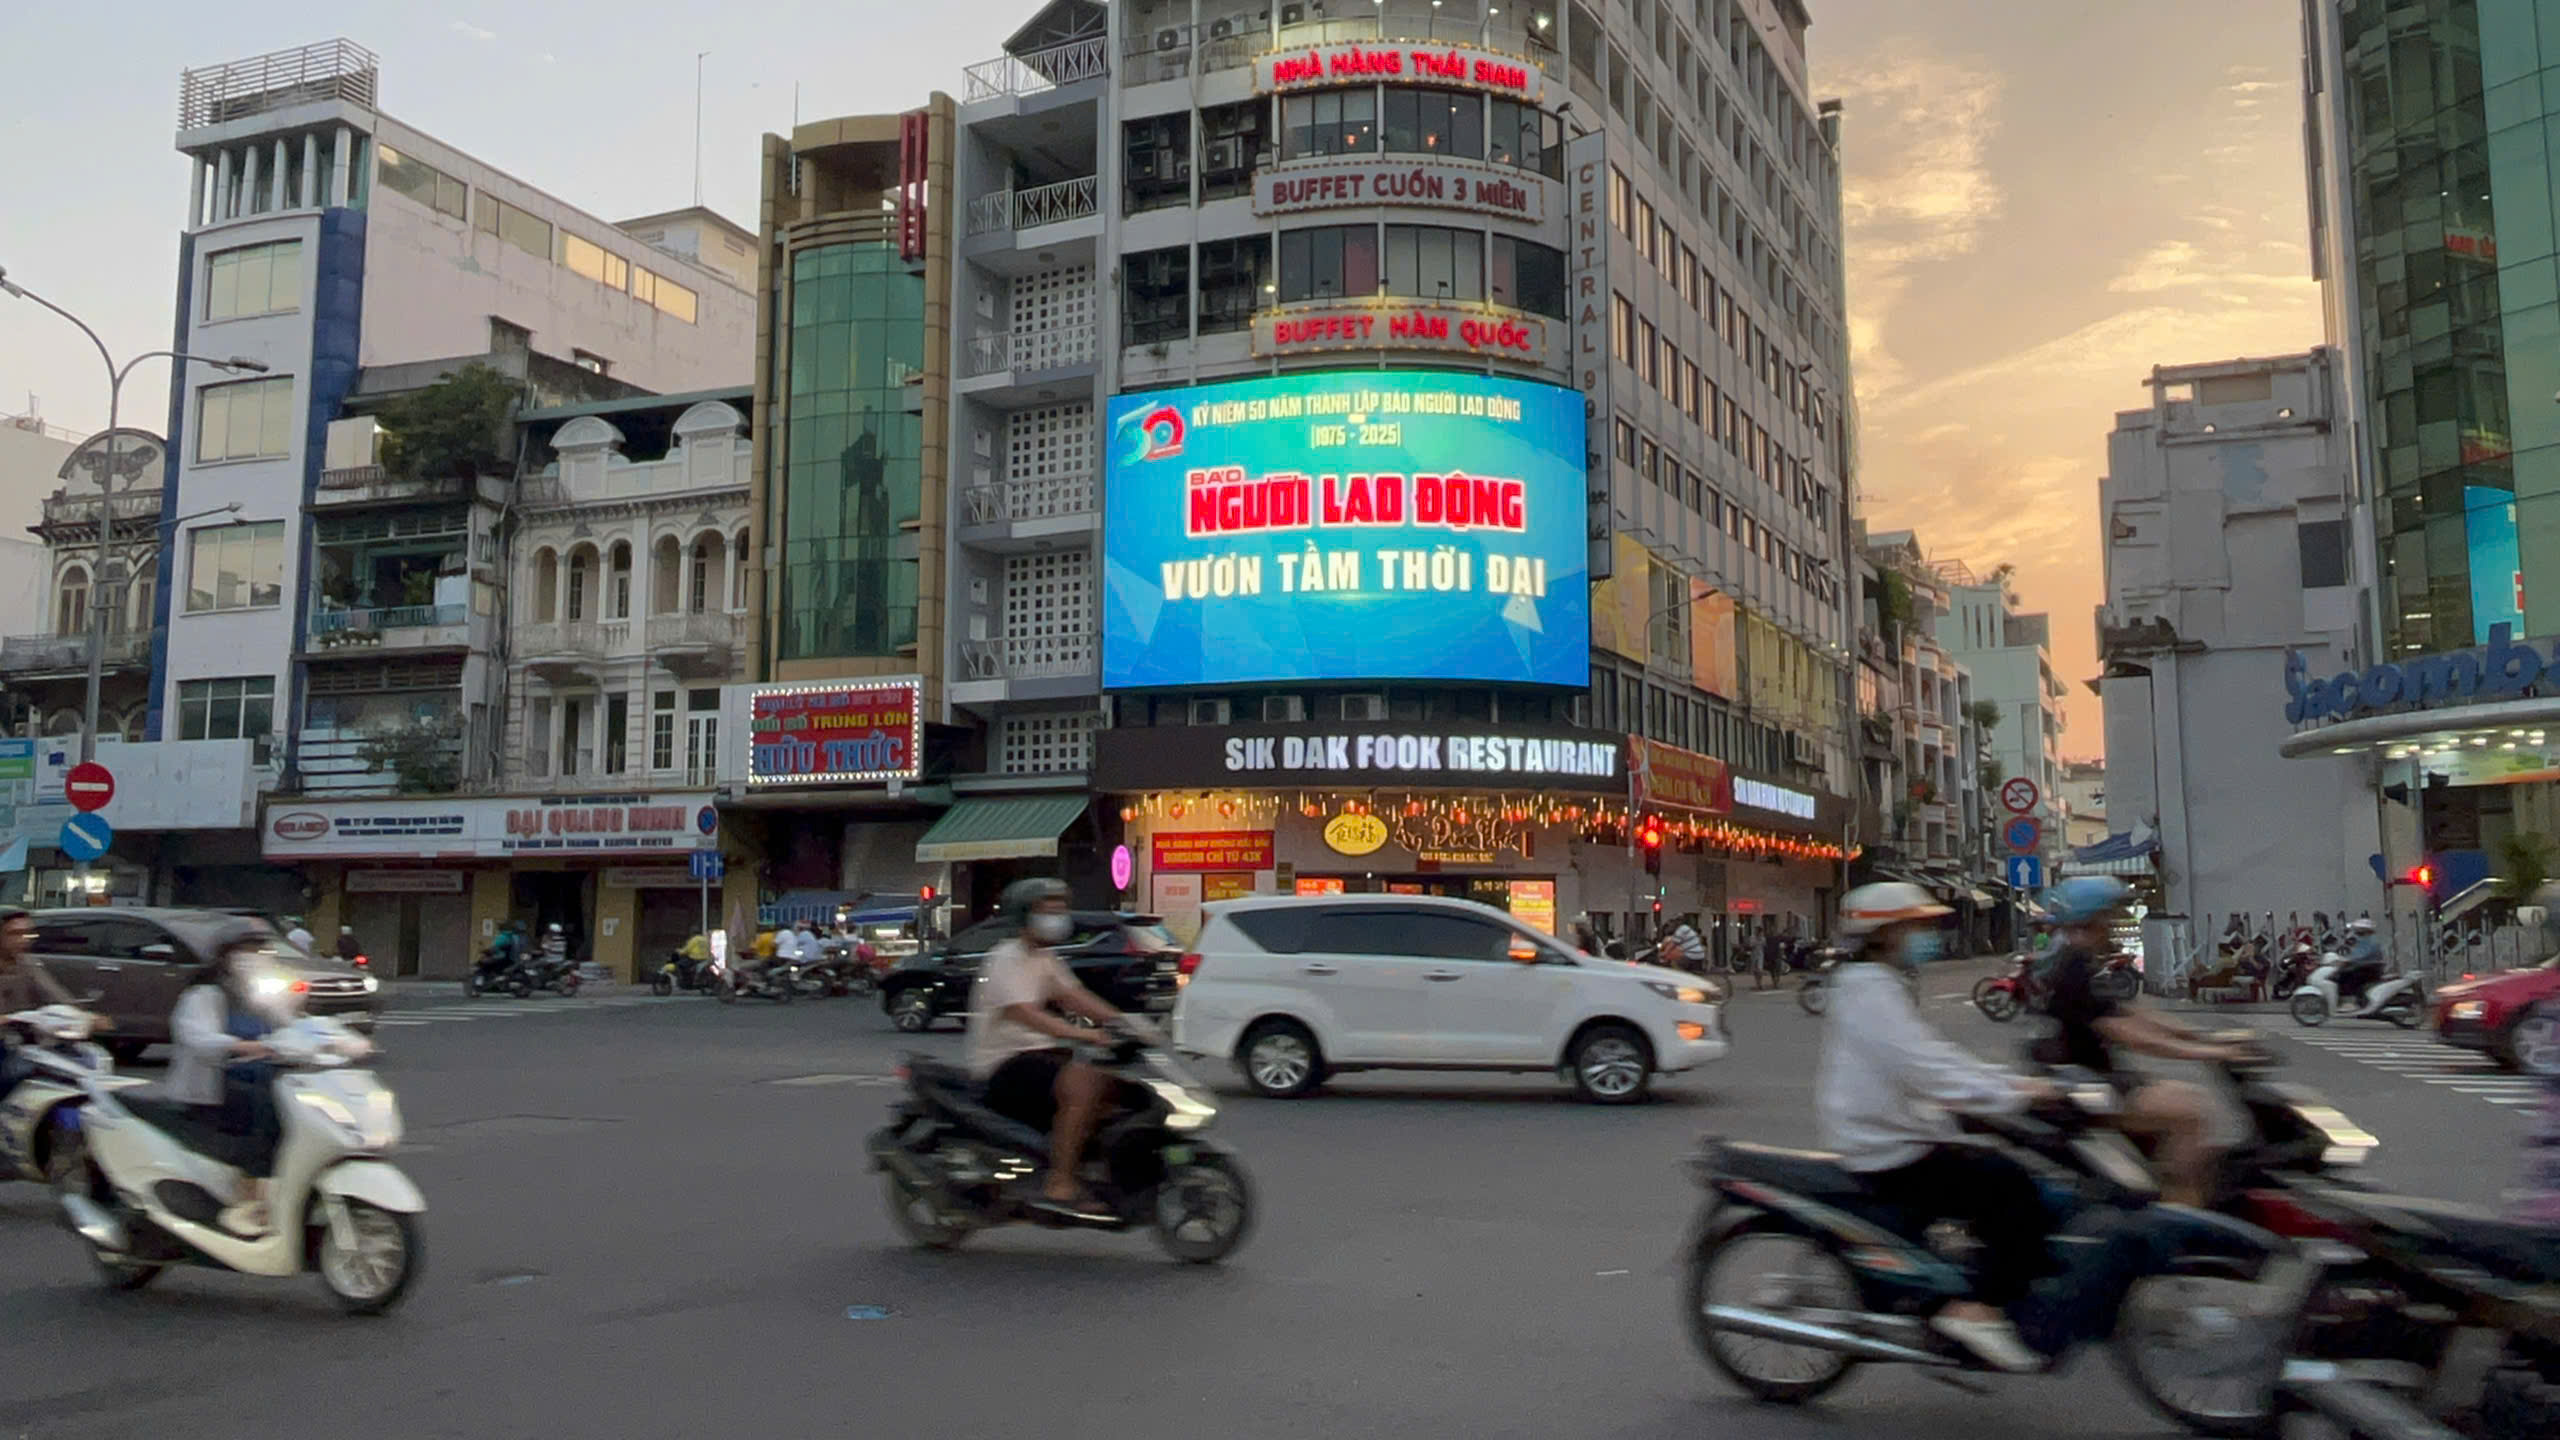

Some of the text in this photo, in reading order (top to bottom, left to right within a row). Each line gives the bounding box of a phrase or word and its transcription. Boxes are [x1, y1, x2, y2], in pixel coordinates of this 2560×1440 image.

[1273, 44, 1527, 91] NHÀ HÀNG THÁI SIAM
[1273, 168, 1527, 212] BUFFET CUỐN 3 MIỀN
[1579, 163, 1597, 353] CENTRAL
[1274, 310, 1532, 351] BUFFET HÀN QUỐC
[1249, 401, 1266, 421] 50
[1269, 395, 1302, 417] NĂM
[1306, 391, 1350, 415] THÀNH
[1460, 395, 1483, 416] LAO
[1190, 469, 1242, 485] BÁO
[1190, 475, 1310, 533] NGƯỜI
[1322, 477, 1401, 524] LAO
[1413, 472, 1524, 531] ĐỘNG
[1162, 538, 1546, 602] VƯƠN TẦM THỜI ĐẠI
[1225, 737, 1275, 771] SIK
[1283, 736, 1350, 770] DAK
[1357, 735, 1442, 770] FOOK
[1448, 735, 1617, 777] RESTAURANT
